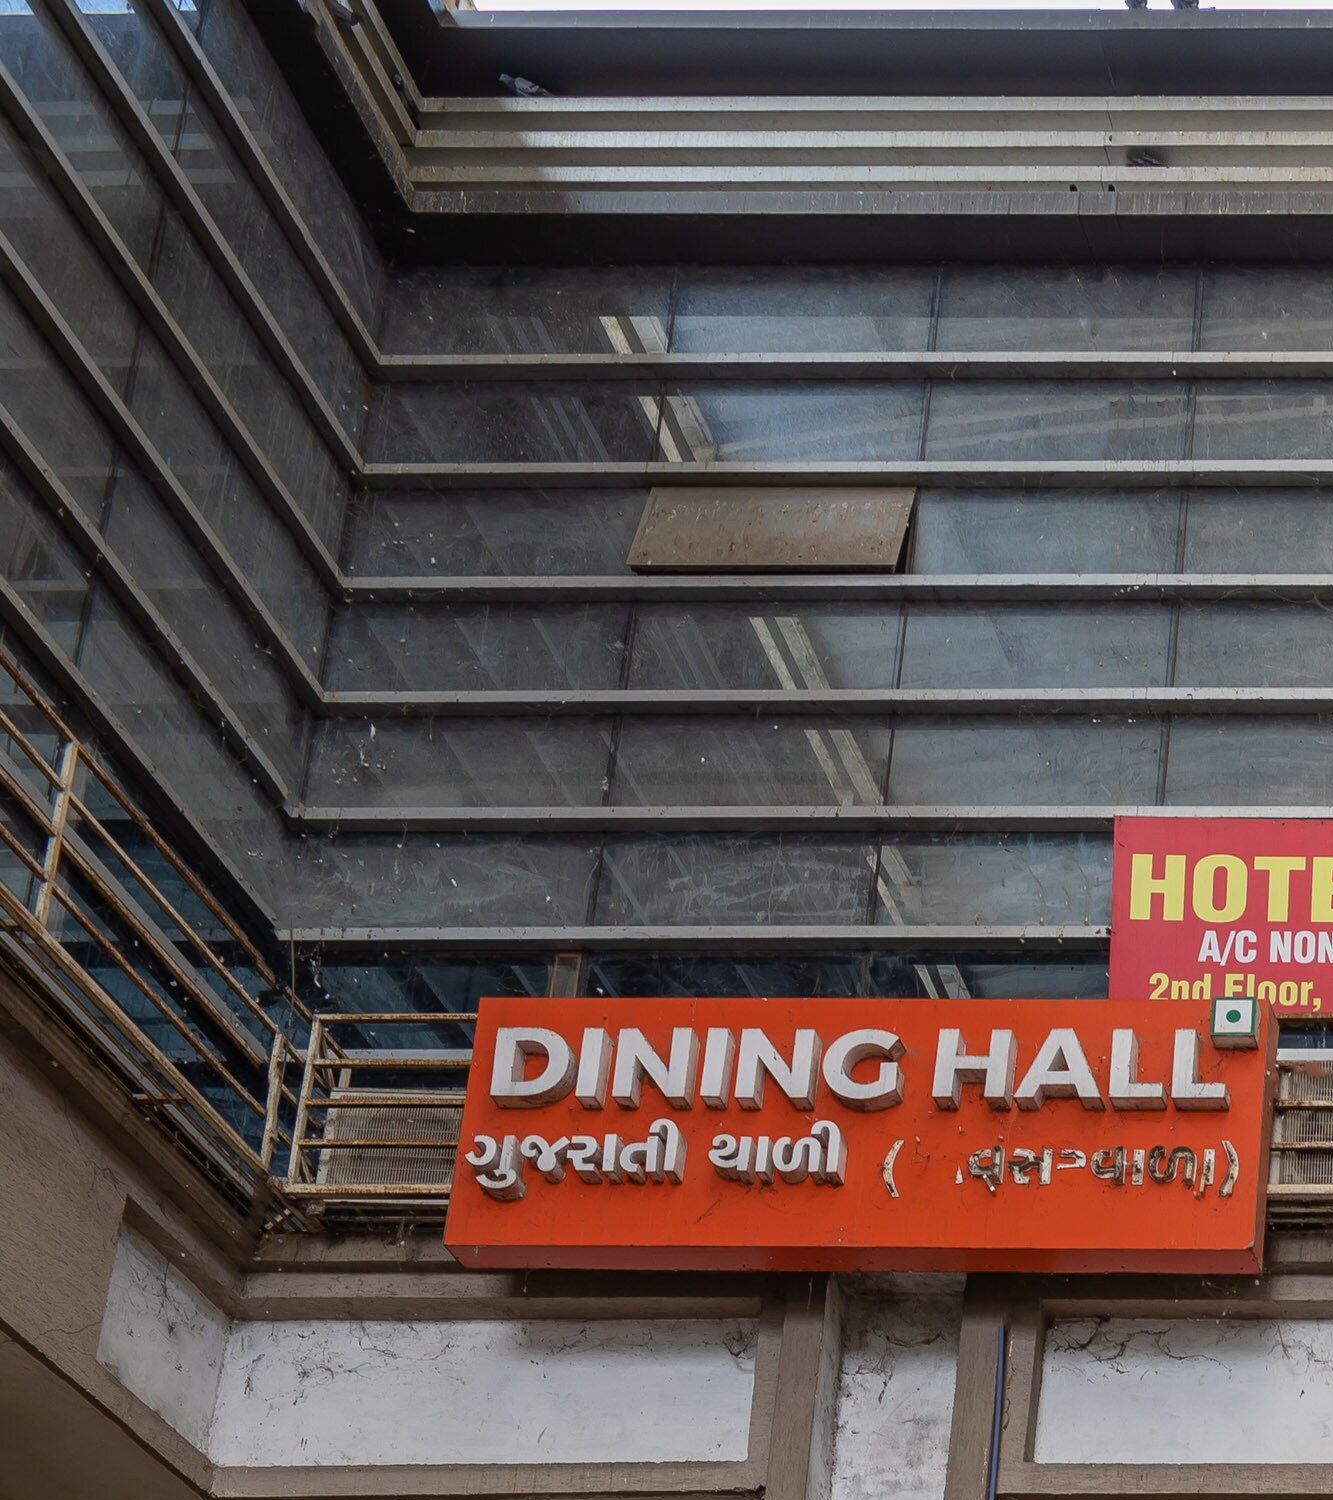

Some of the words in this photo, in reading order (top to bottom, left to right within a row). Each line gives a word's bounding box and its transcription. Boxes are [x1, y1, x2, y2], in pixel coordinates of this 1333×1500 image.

[1198, 929, 1258, 967] A/C
[1148, 972, 1212, 1000] 2nd
[1224, 973, 1323, 1012] Floor,
[489, 1026, 908, 1112] DINING
[931, 1027, 1232, 1112] HALL
[465, 1117, 688, 1201] ગુજરાતી
[708, 1118, 849, 1188] થાળી
